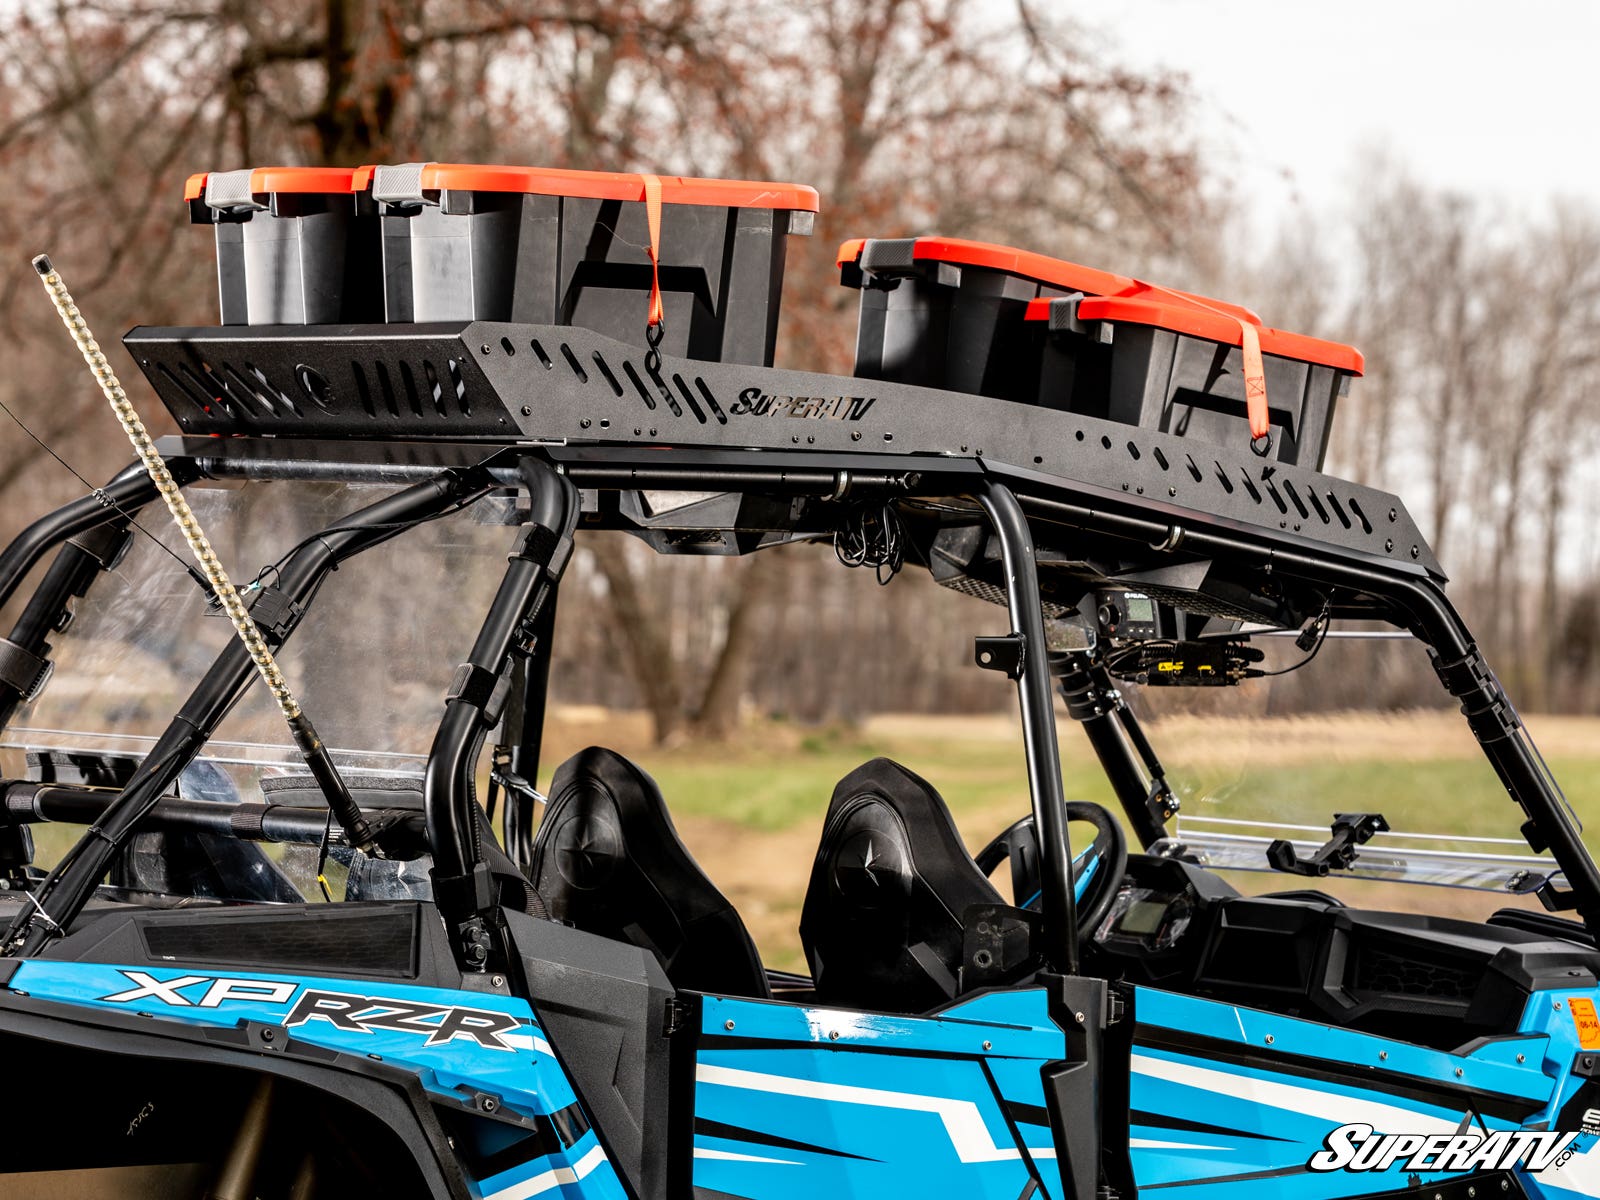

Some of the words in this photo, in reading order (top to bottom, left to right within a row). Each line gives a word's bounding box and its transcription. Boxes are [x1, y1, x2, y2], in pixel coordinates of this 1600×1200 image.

[729, 387, 877, 421] SUPERATV
[101, 969, 298, 1008] XP
[282, 988, 521, 1053] RZR
